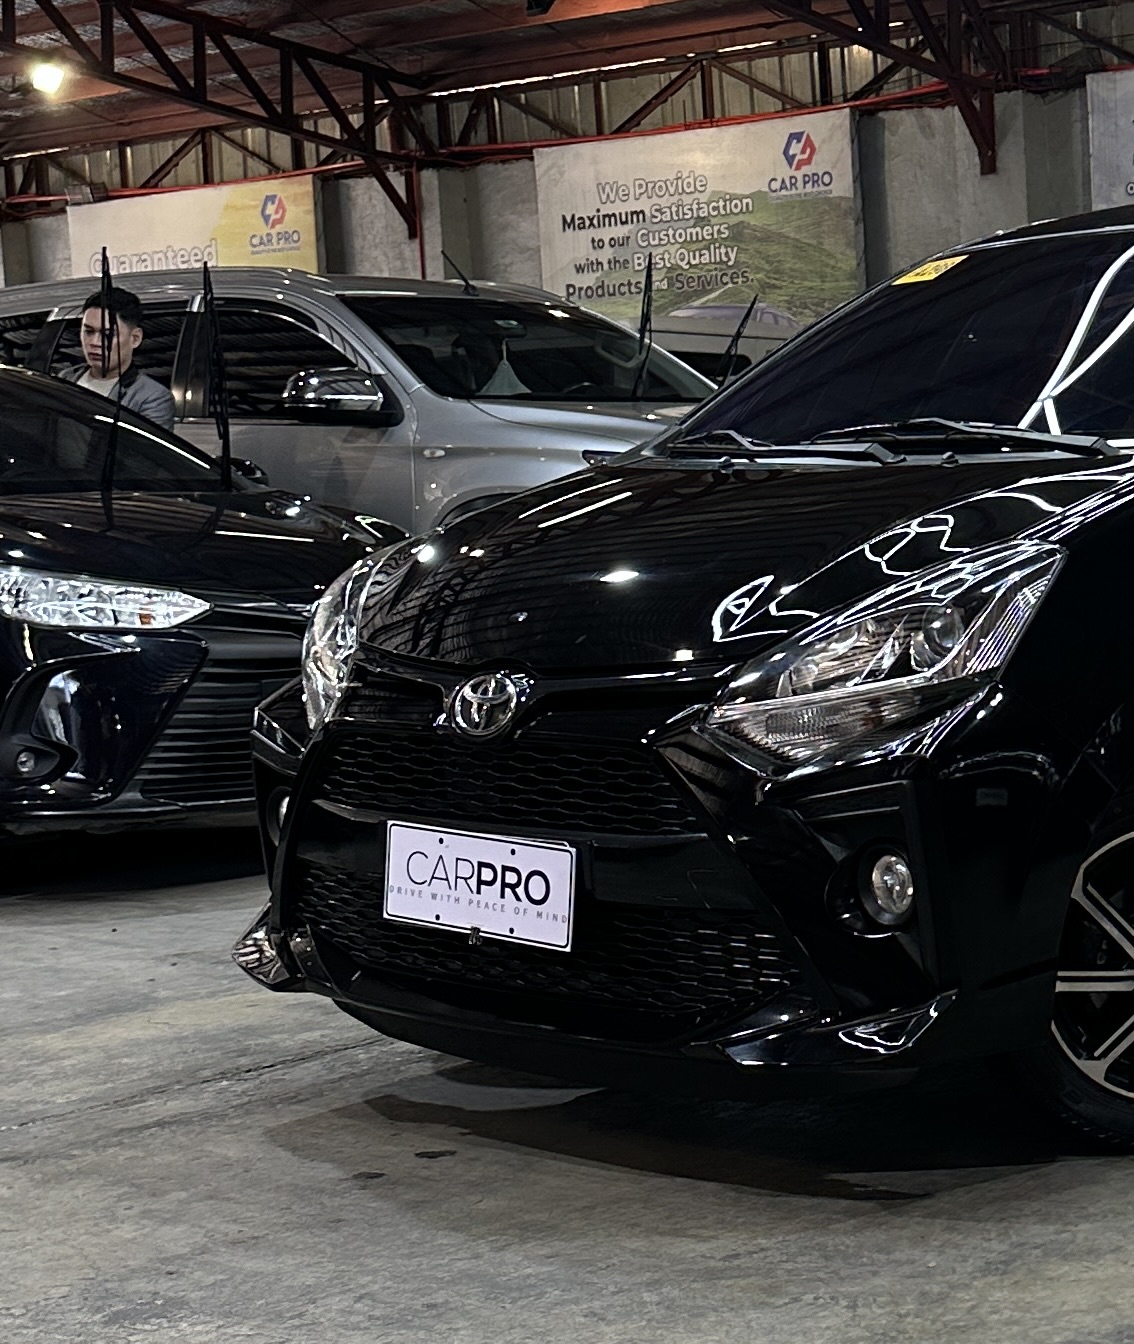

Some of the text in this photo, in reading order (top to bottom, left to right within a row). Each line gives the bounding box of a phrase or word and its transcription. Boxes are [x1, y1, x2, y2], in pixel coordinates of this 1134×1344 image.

[597, 171, 707, 204] We Provide
[768, 171, 833, 193] CAR PRO
[561, 208, 646, 233] Maximum
[650, 194, 753, 224] Satisfaction
[250, 229, 301, 248] CAR PRO
[591, 223, 729, 250] to our Customers
[89, 238, 217, 277] Guaranteed
[574, 258, 604, 275] with
[607, 255, 630, 271] the
[675, 242, 738, 270] Quality
[565, 267, 755, 303] Products nd Services.
[406, 850, 551, 906] CARPRO
[389, 885, 568, 924] DRIVE WITH PEACE OF MIND
